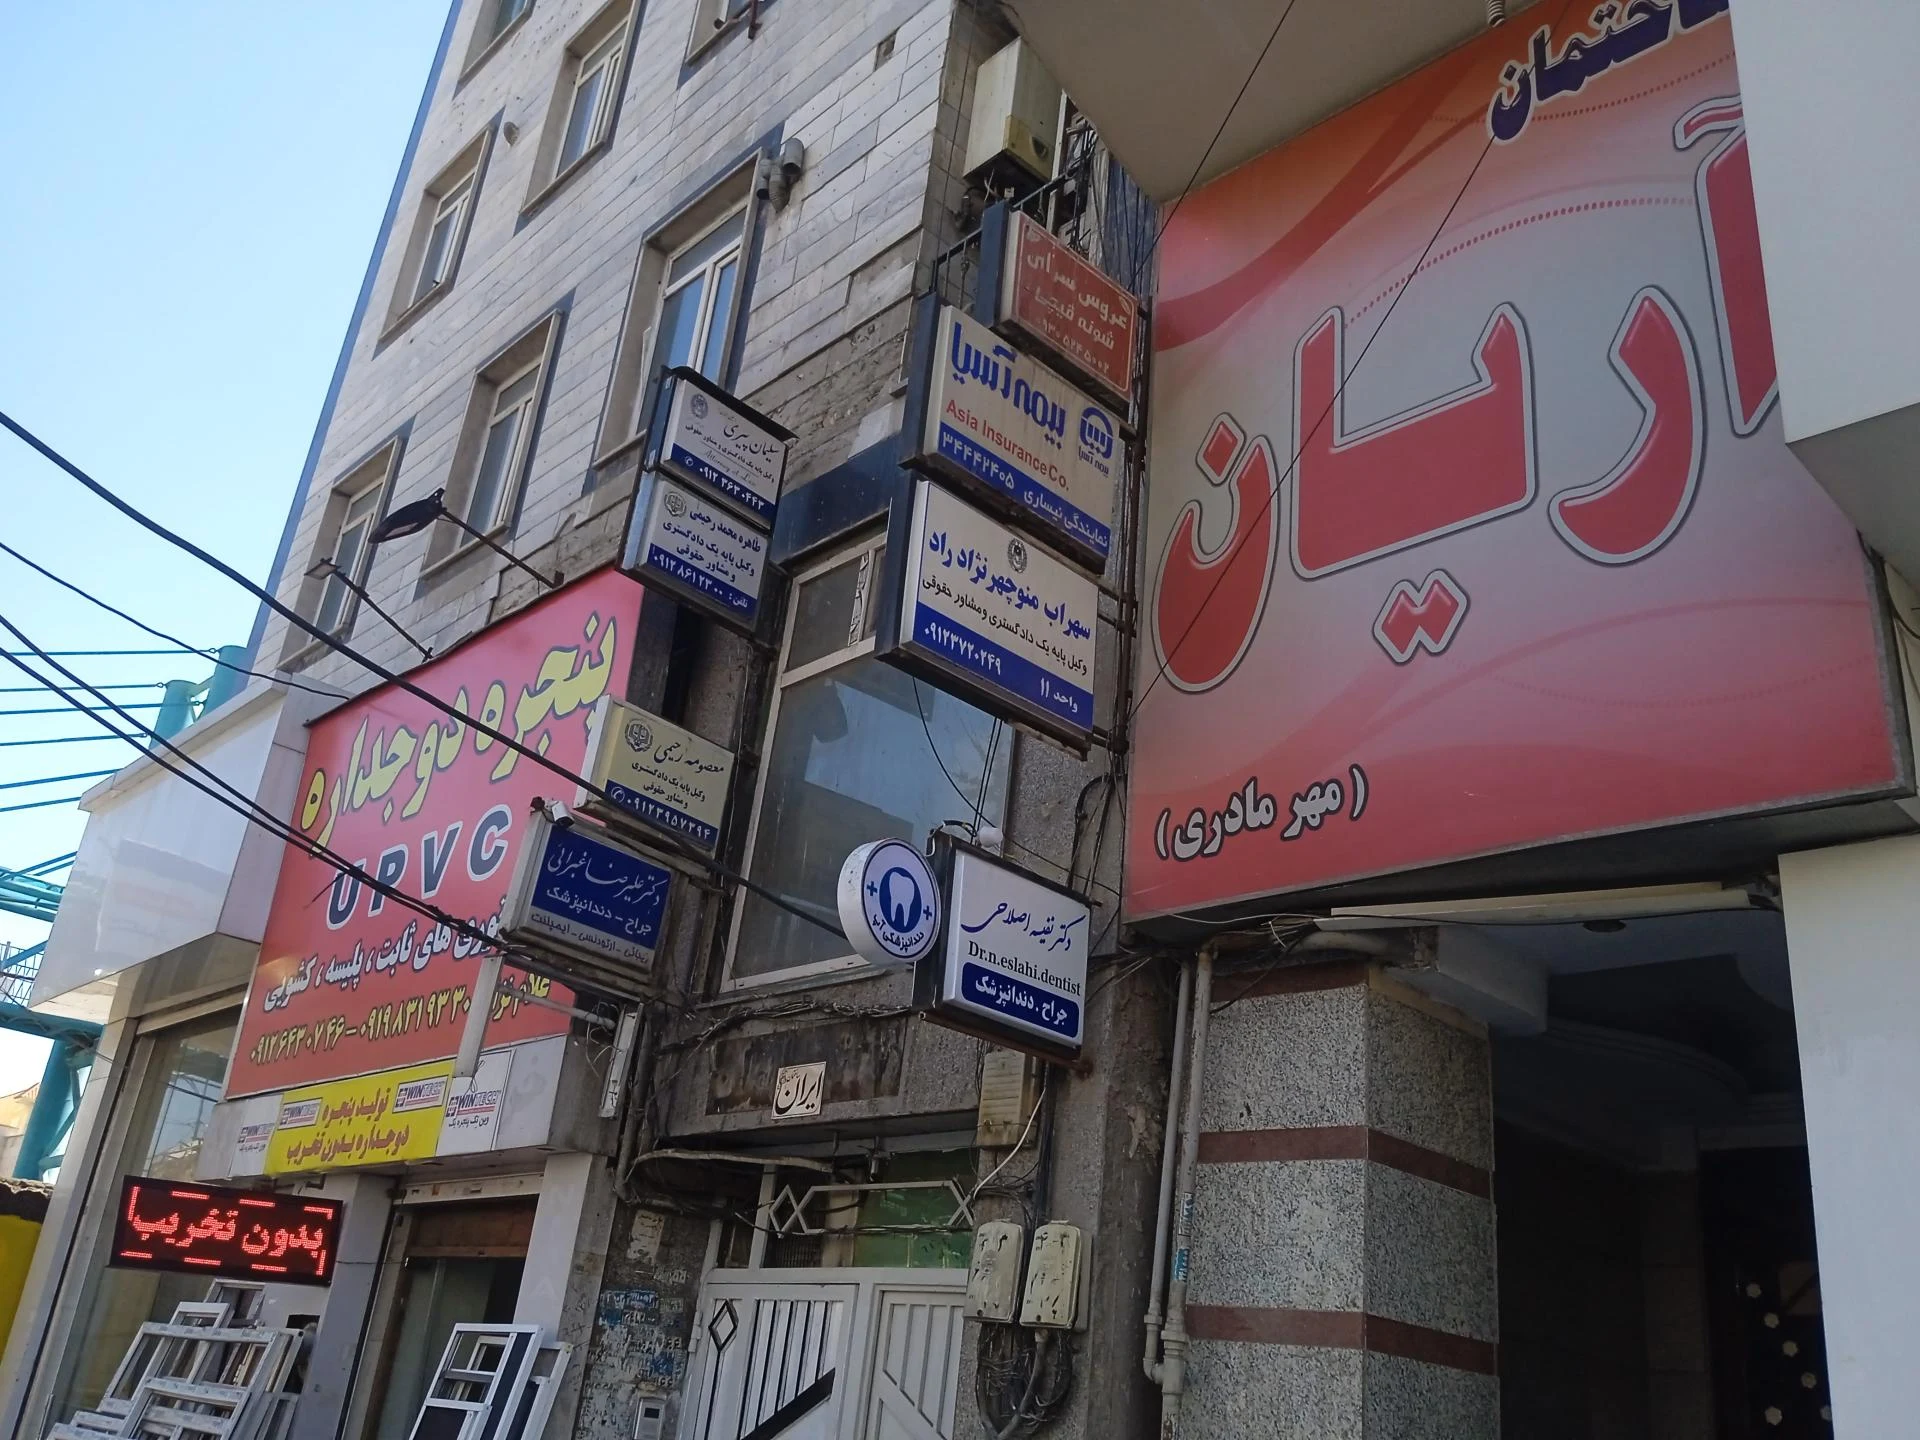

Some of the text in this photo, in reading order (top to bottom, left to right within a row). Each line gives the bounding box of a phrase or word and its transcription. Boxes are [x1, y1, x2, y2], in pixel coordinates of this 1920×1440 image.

[1027, 252, 1128, 329] عروس سرای
[951, 321, 1067, 450] بیمه آسیا
[1153, 95, 1778, 693] آریان
[749, 440, 779, 462] سلیمان
[946, 399, 1070, 492] Asia Insurance Co.
[1023, 487, 1064, 520] نیساری
[738, 534, 760, 553] طاهره
[1063, 512, 1108, 547] نمایندگی
[677, 544, 704, 561] حقوقی
[706, 543, 718, 557] یک
[721, 551, 734, 566] پایه
[929, 531, 953, 567] راد
[736, 559, 754, 576] وکیل
[922, 575, 952, 598] حقوقی
[989, 615, 1034, 644] دادگستری
[1043, 602, 1090, 640] سهراب
[1036, 639, 1050, 656] یک
[1052, 645, 1067, 667] پایه
[1068, 655, 1088, 676] وکیل
[474, 610, 617, 783] پنجره
[1040, 677, 1078, 713] واحد ۱۱
[654, 742, 724, 773] معصومه رحیمی
[669, 778, 678, 788] یک
[690, 788, 705, 802] وکیل
[326, 804, 513, 931] UPVC
[585, 858, 644, 902] علیرضا
[632, 875, 668, 905] دکتر
[531, 914, 570, 934] ایمپلنت
[546, 887, 651, 935] جراح دندانپزشک
[960, 902, 1086, 951] دکتر نفیسه اصلاحی
[882, 932, 924, 953] دندانپزشکی
[264, 954, 318, 1013] کشویی
[967, 940, 1081, 997] Dr.n.eslahi.dentist
[975, 975, 1067, 1025] جراح دندانپزشک
[322, 1087, 391, 1128] تولید پنجره
[775, 1071, 823, 1114] ایران
[287, 1131, 325, 1165] تخریب
[320, 1133, 355, 1161] بدون
[133, 1208, 324, 1258] بدون تخریب
